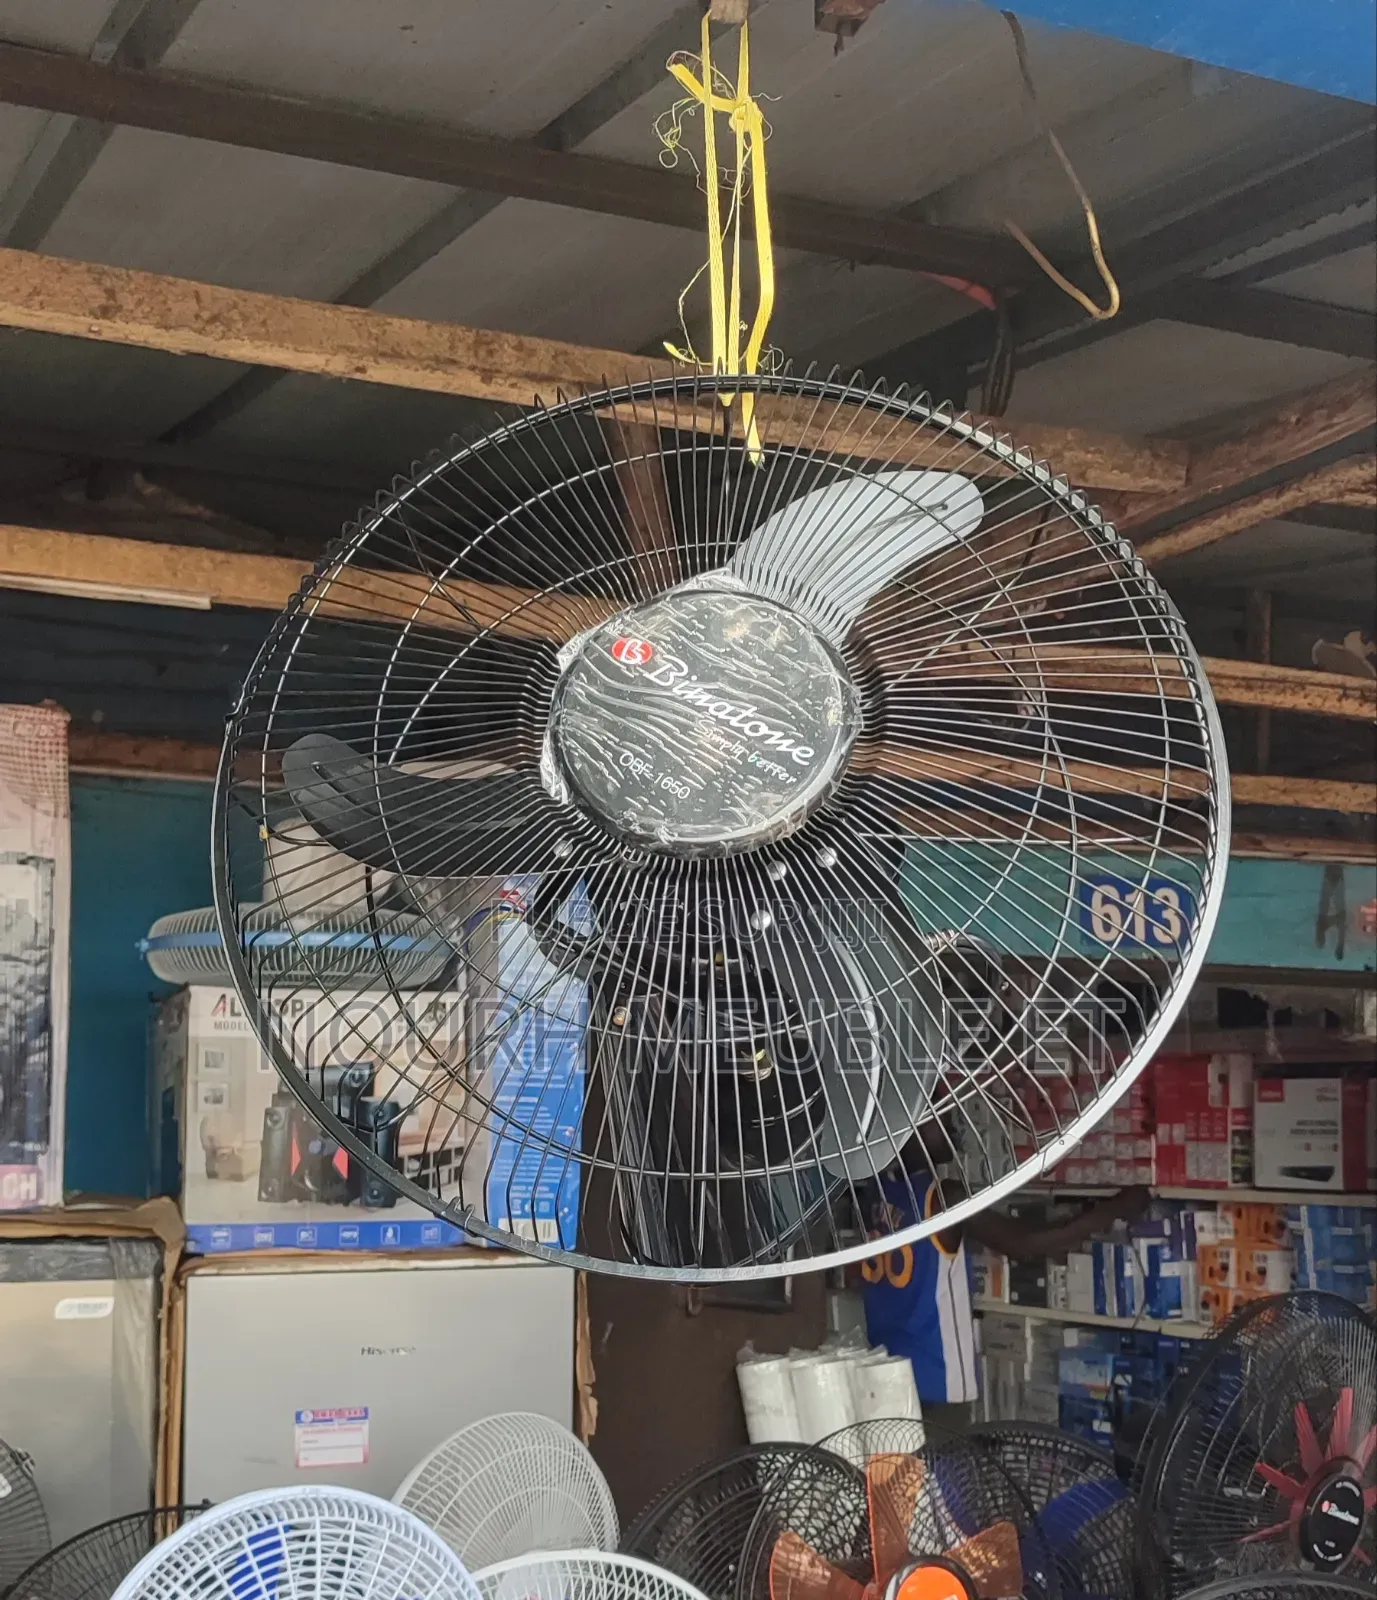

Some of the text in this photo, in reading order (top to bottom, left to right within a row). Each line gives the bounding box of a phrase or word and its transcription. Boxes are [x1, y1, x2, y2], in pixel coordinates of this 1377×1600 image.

[643, 654, 815, 766] Binatone
[747, 750, 798, 784] better
[1091, 884, 1181, 944] 613
